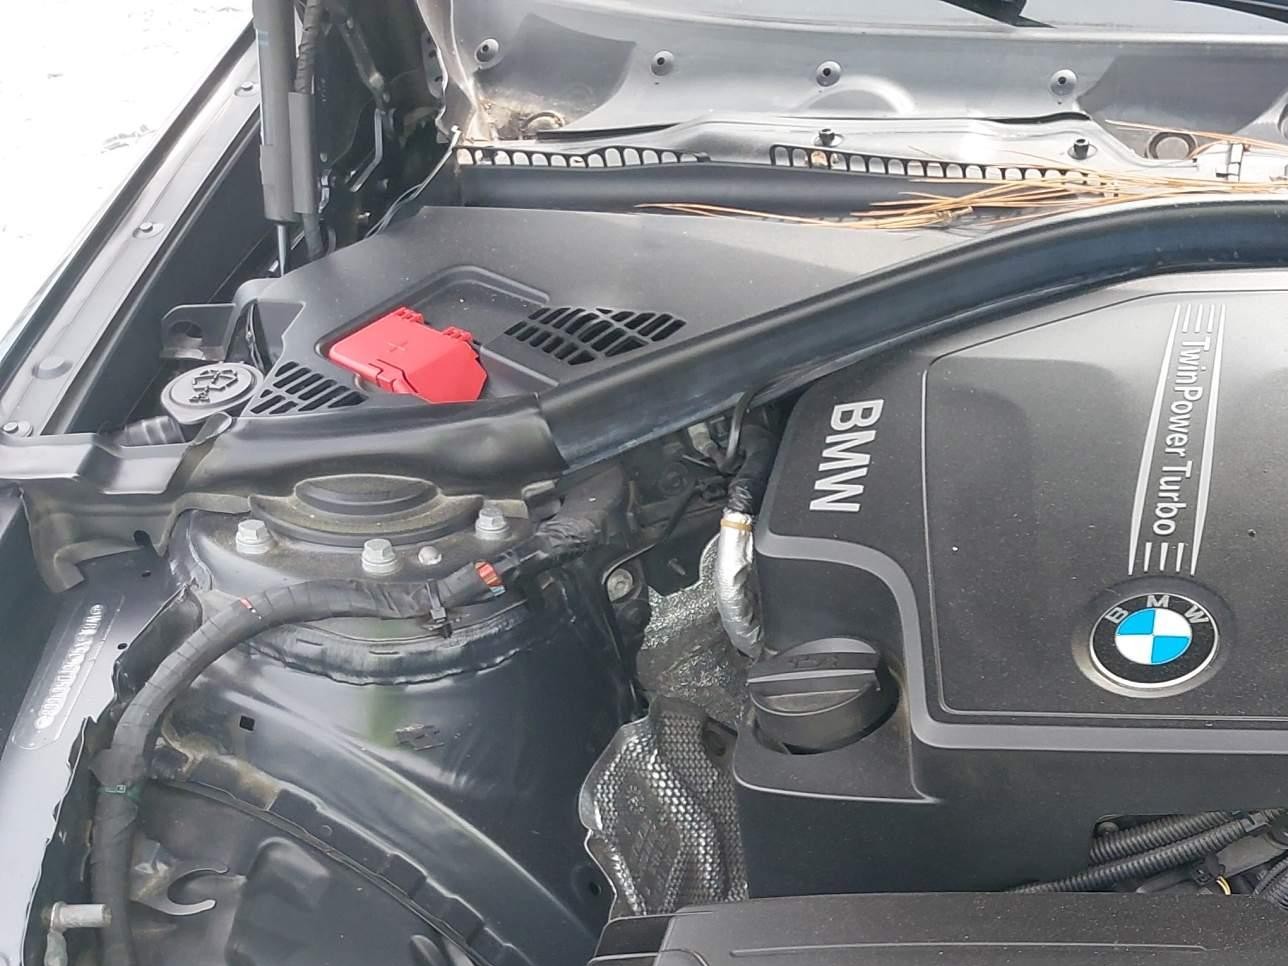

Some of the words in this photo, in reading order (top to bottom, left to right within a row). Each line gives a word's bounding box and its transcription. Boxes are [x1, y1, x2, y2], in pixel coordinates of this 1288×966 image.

[1164, 336, 1211, 457] TwinPower
[809, 399, 884, 512] BMW
[1152, 460, 1193, 537] Turbo
[1104, 594, 1209, 626] BMW
